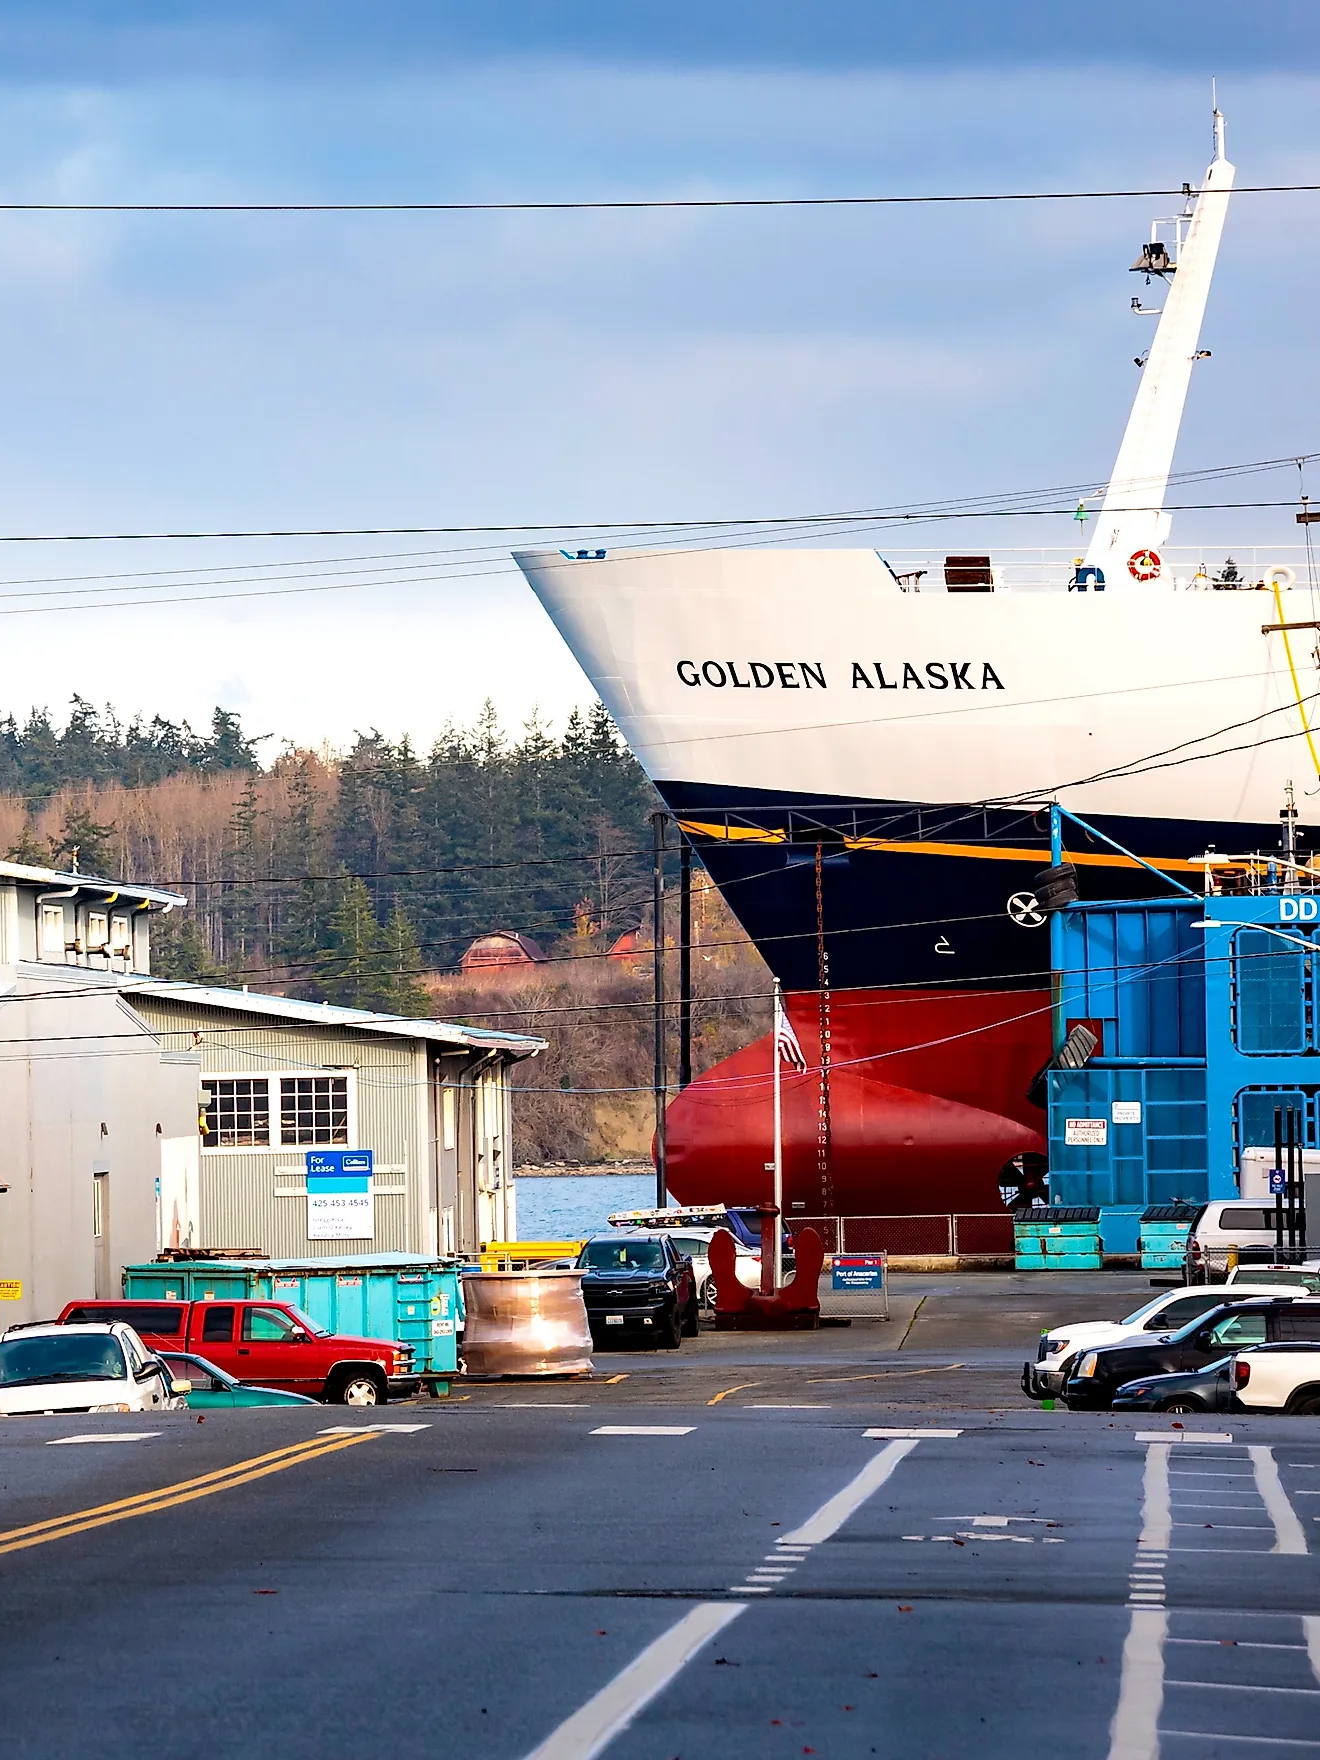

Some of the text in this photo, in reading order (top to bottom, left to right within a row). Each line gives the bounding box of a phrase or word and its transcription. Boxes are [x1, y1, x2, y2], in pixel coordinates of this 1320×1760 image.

[676, 660, 1006, 690] GOLDEN ALASKA
[1279, 897, 1318, 921] DD
[310, 1156, 325, 1164] For
[310, 1165, 335, 1173] Lease
[348, 1199, 370, 1207] 4545
